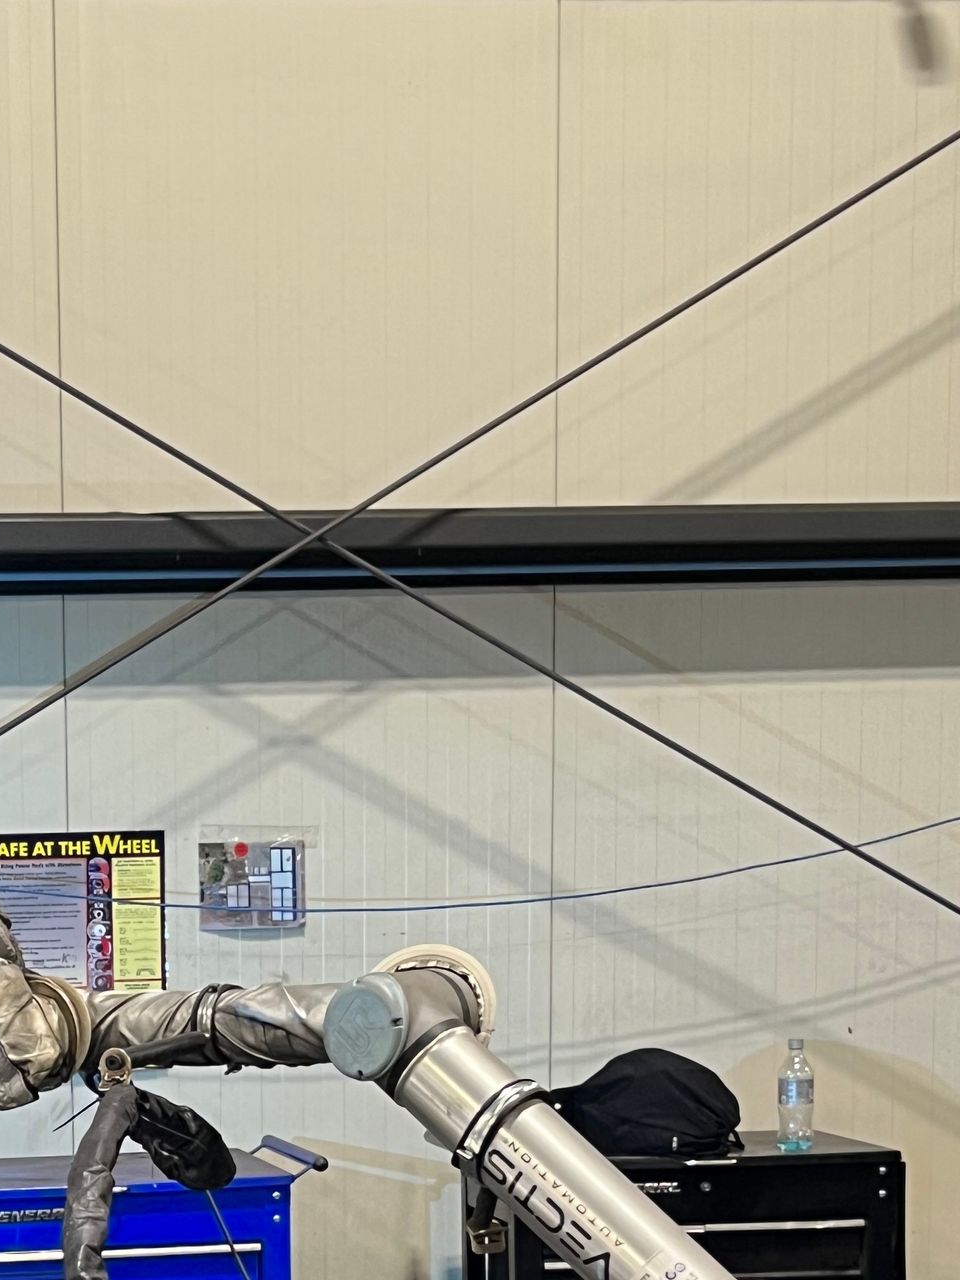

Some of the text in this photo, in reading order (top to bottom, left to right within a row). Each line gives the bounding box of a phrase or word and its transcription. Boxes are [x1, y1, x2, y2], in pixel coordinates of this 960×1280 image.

[32, 841, 54, 856] AT
[58, 840, 91, 856] THE
[93, 834, 160, 854] WHEEL
[508, 1141, 625, 1247] AUTOMATION
